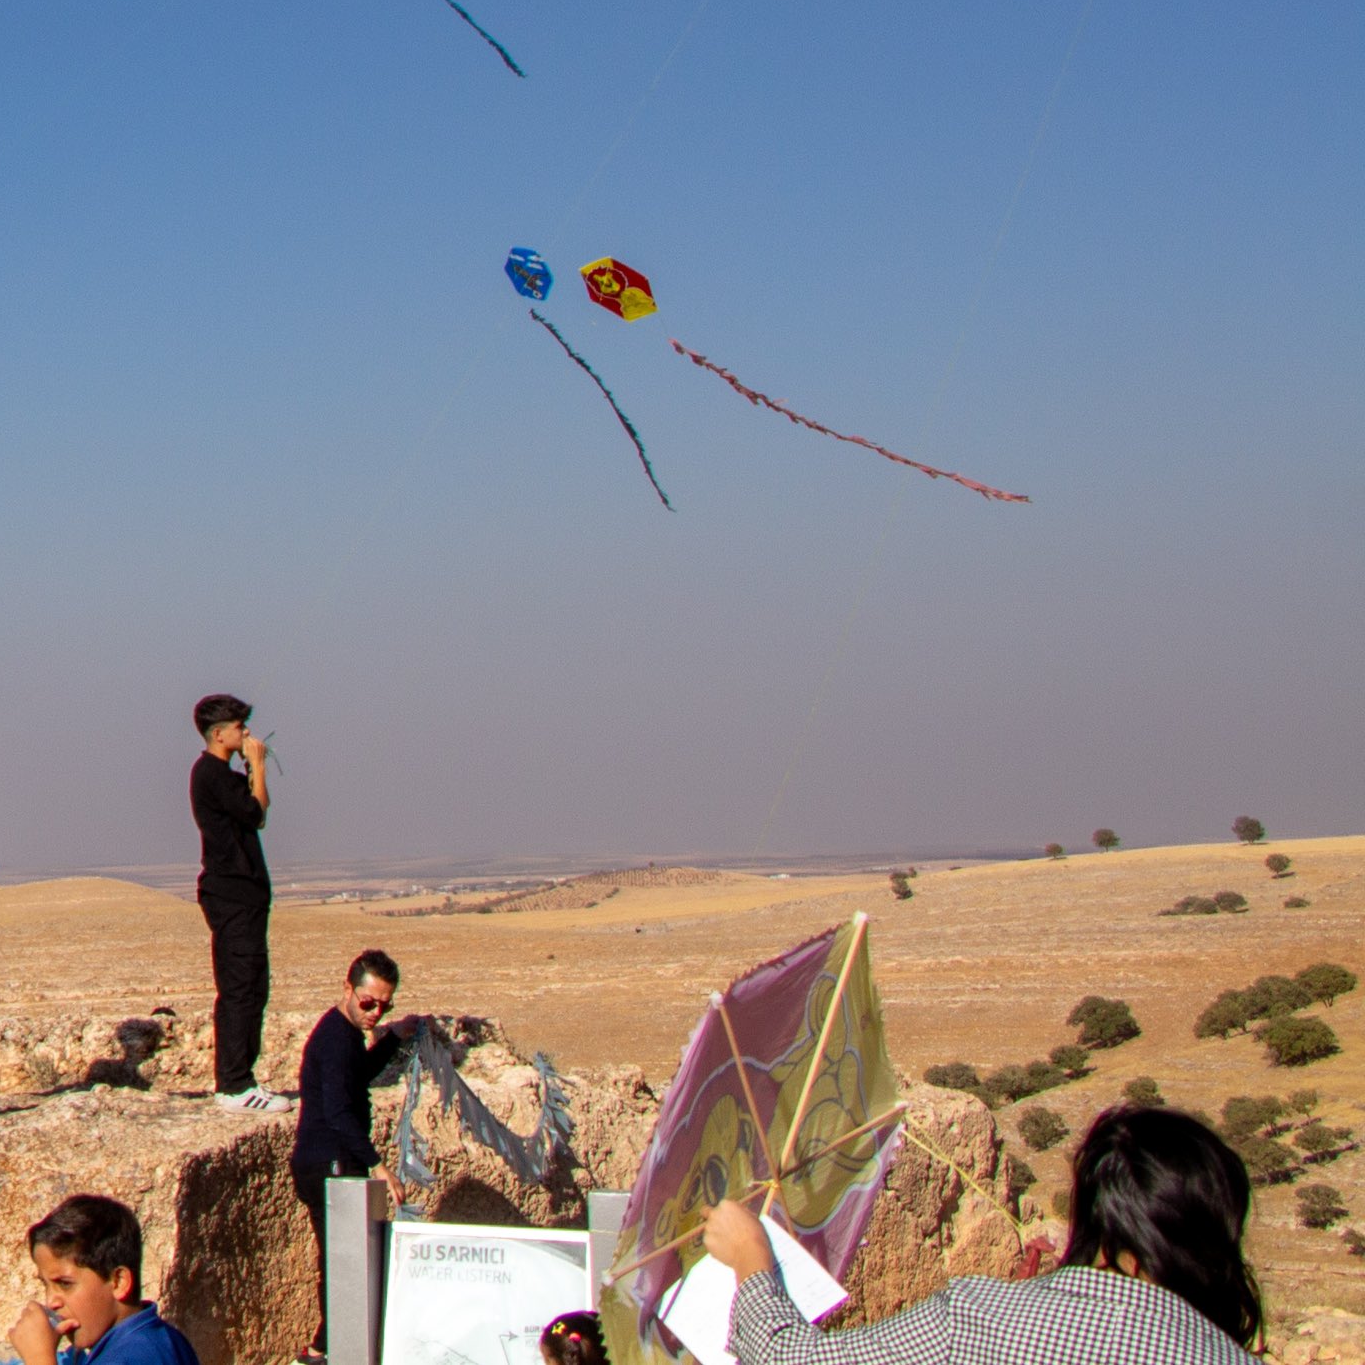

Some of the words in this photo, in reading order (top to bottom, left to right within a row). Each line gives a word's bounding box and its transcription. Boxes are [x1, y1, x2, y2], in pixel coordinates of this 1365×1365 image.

[410, 1244, 431, 1261] SU
[436, 1245, 504, 1264] SARNICI
[409, 1266, 453, 1281] WATER
